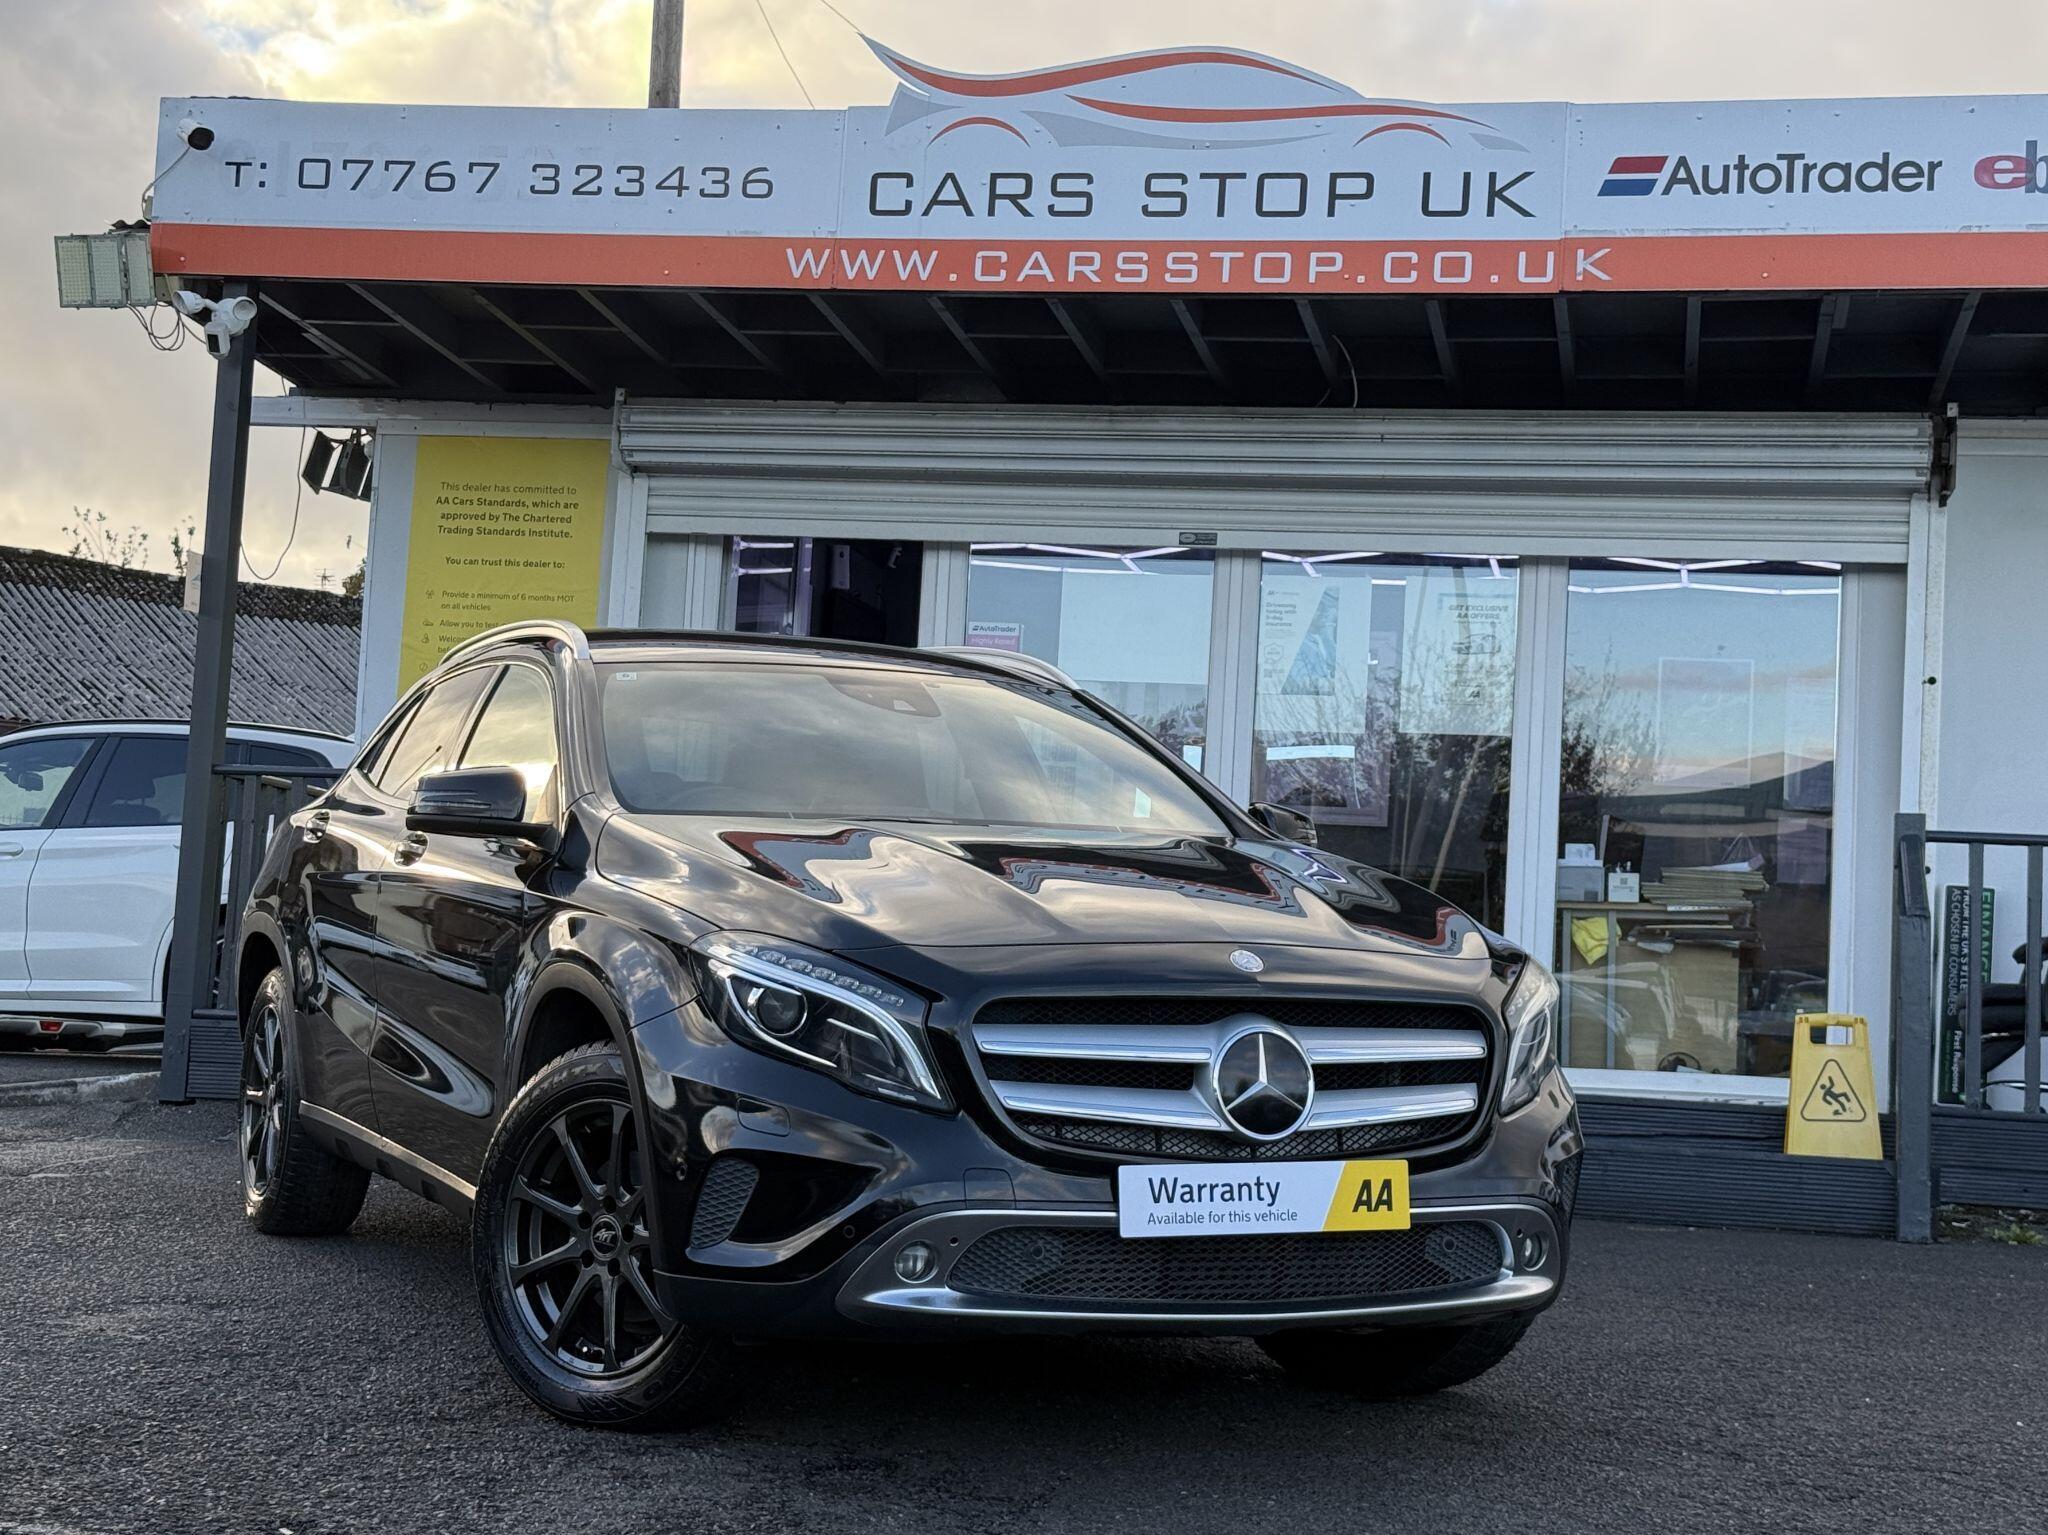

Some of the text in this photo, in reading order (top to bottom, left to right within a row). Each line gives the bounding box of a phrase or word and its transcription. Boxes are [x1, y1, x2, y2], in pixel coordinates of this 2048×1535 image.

[225, 160, 267, 188] T:
[298, 158, 501, 194] 07767
[529, 163, 775, 199] 323436
[1661, 151, 1943, 196] AutoTrader
[868, 171, 1537, 217] CARS STOP UK
[786, 247, 1612, 284] WWW.CARSSTOP.CO.UK
[440, 482, 577, 495] This dealer has committed to
[436, 496, 450, 505] AA
[452, 497, 474, 506] Cars
[476, 498, 529, 508] Standards,
[532, 500, 561, 509] which
[440, 512, 572, 524] approved by The Chartered
[437, 525, 573, 538] Trading Standards Institute.
[445, 557, 566, 569] You can trust this dealer to:
[442, 591, 469, 599] Provide
[477, 592, 510, 600] minimum
[528, 594, 555, 602] months
[557, 595, 575, 603] MOT
[462, 603, 491, 611] vehicles
[440, 619, 459, 627] Allow
[461, 621, 476, 629] you
[1951, 902, 1960, 942] CHOSEN
[1950, 943, 1959, 955] BY
[1148, 1175, 1281, 1207] Warranty
[1352, 1178, 1393, 1213] AA
[1148, 1208, 1298, 1225] Available for this vehicle
